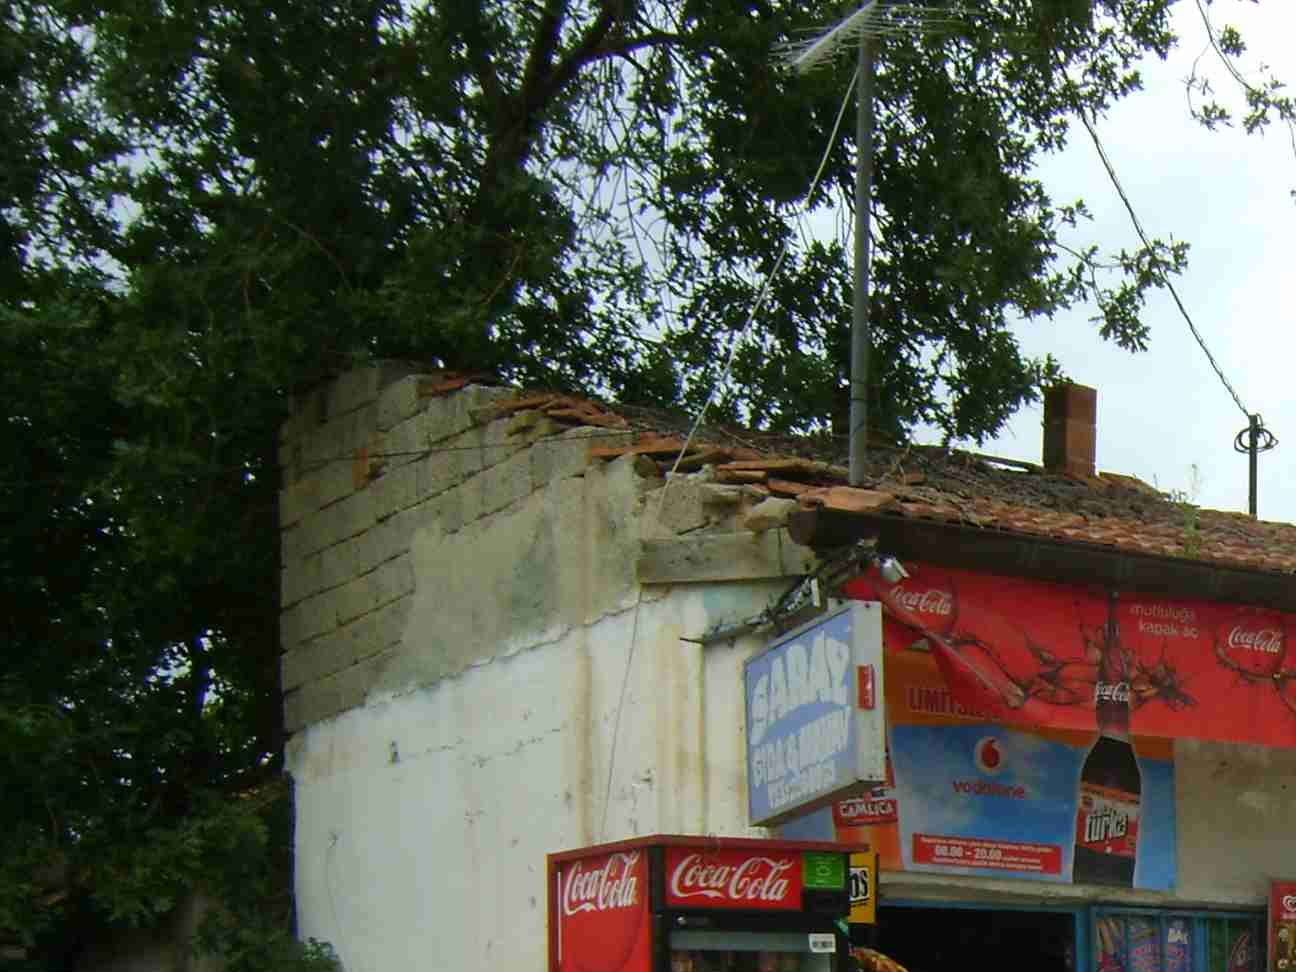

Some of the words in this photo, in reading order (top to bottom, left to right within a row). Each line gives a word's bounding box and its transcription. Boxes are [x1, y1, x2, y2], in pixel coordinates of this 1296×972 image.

[1227, 625, 1283, 653] Coca-Cola
[563, 851, 640, 916] Coca-Cola
[671, 853, 796, 901] Coca-Cola
